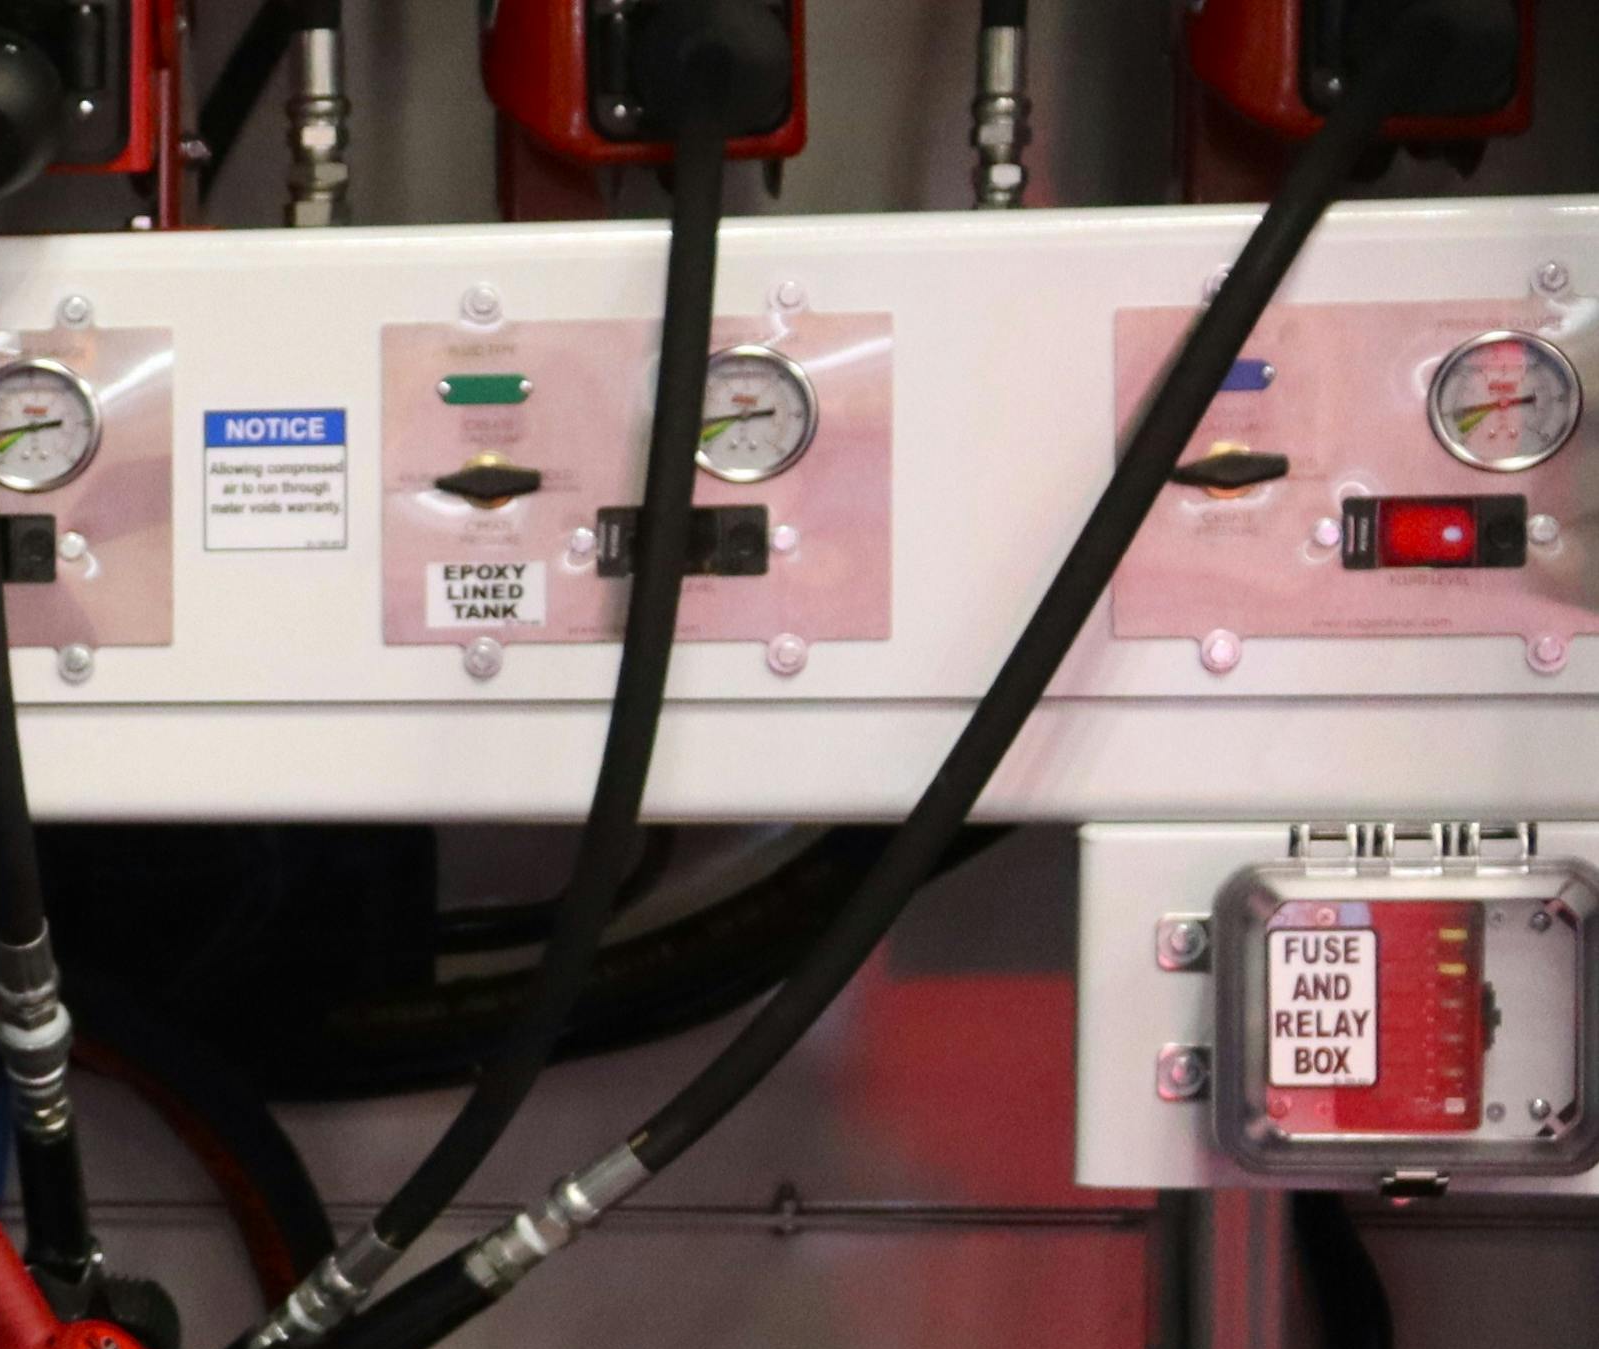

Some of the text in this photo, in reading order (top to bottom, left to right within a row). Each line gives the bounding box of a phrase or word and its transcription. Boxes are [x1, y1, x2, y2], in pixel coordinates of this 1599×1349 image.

[225, 416, 326, 441] NOTICE
[210, 461, 345, 477] Allowing compressed
[223, 481, 330, 496] air to run through
[444, 563, 526, 581] EPOXY
[446, 583, 524, 600] LINED
[453, 603, 518, 620] TANK
[1284, 936, 1361, 965] FUSE
[1292, 974, 1351, 1001] AND
[1275, 1010, 1371, 1039] RELAY
[1294, 1048, 1351, 1075] BOX
